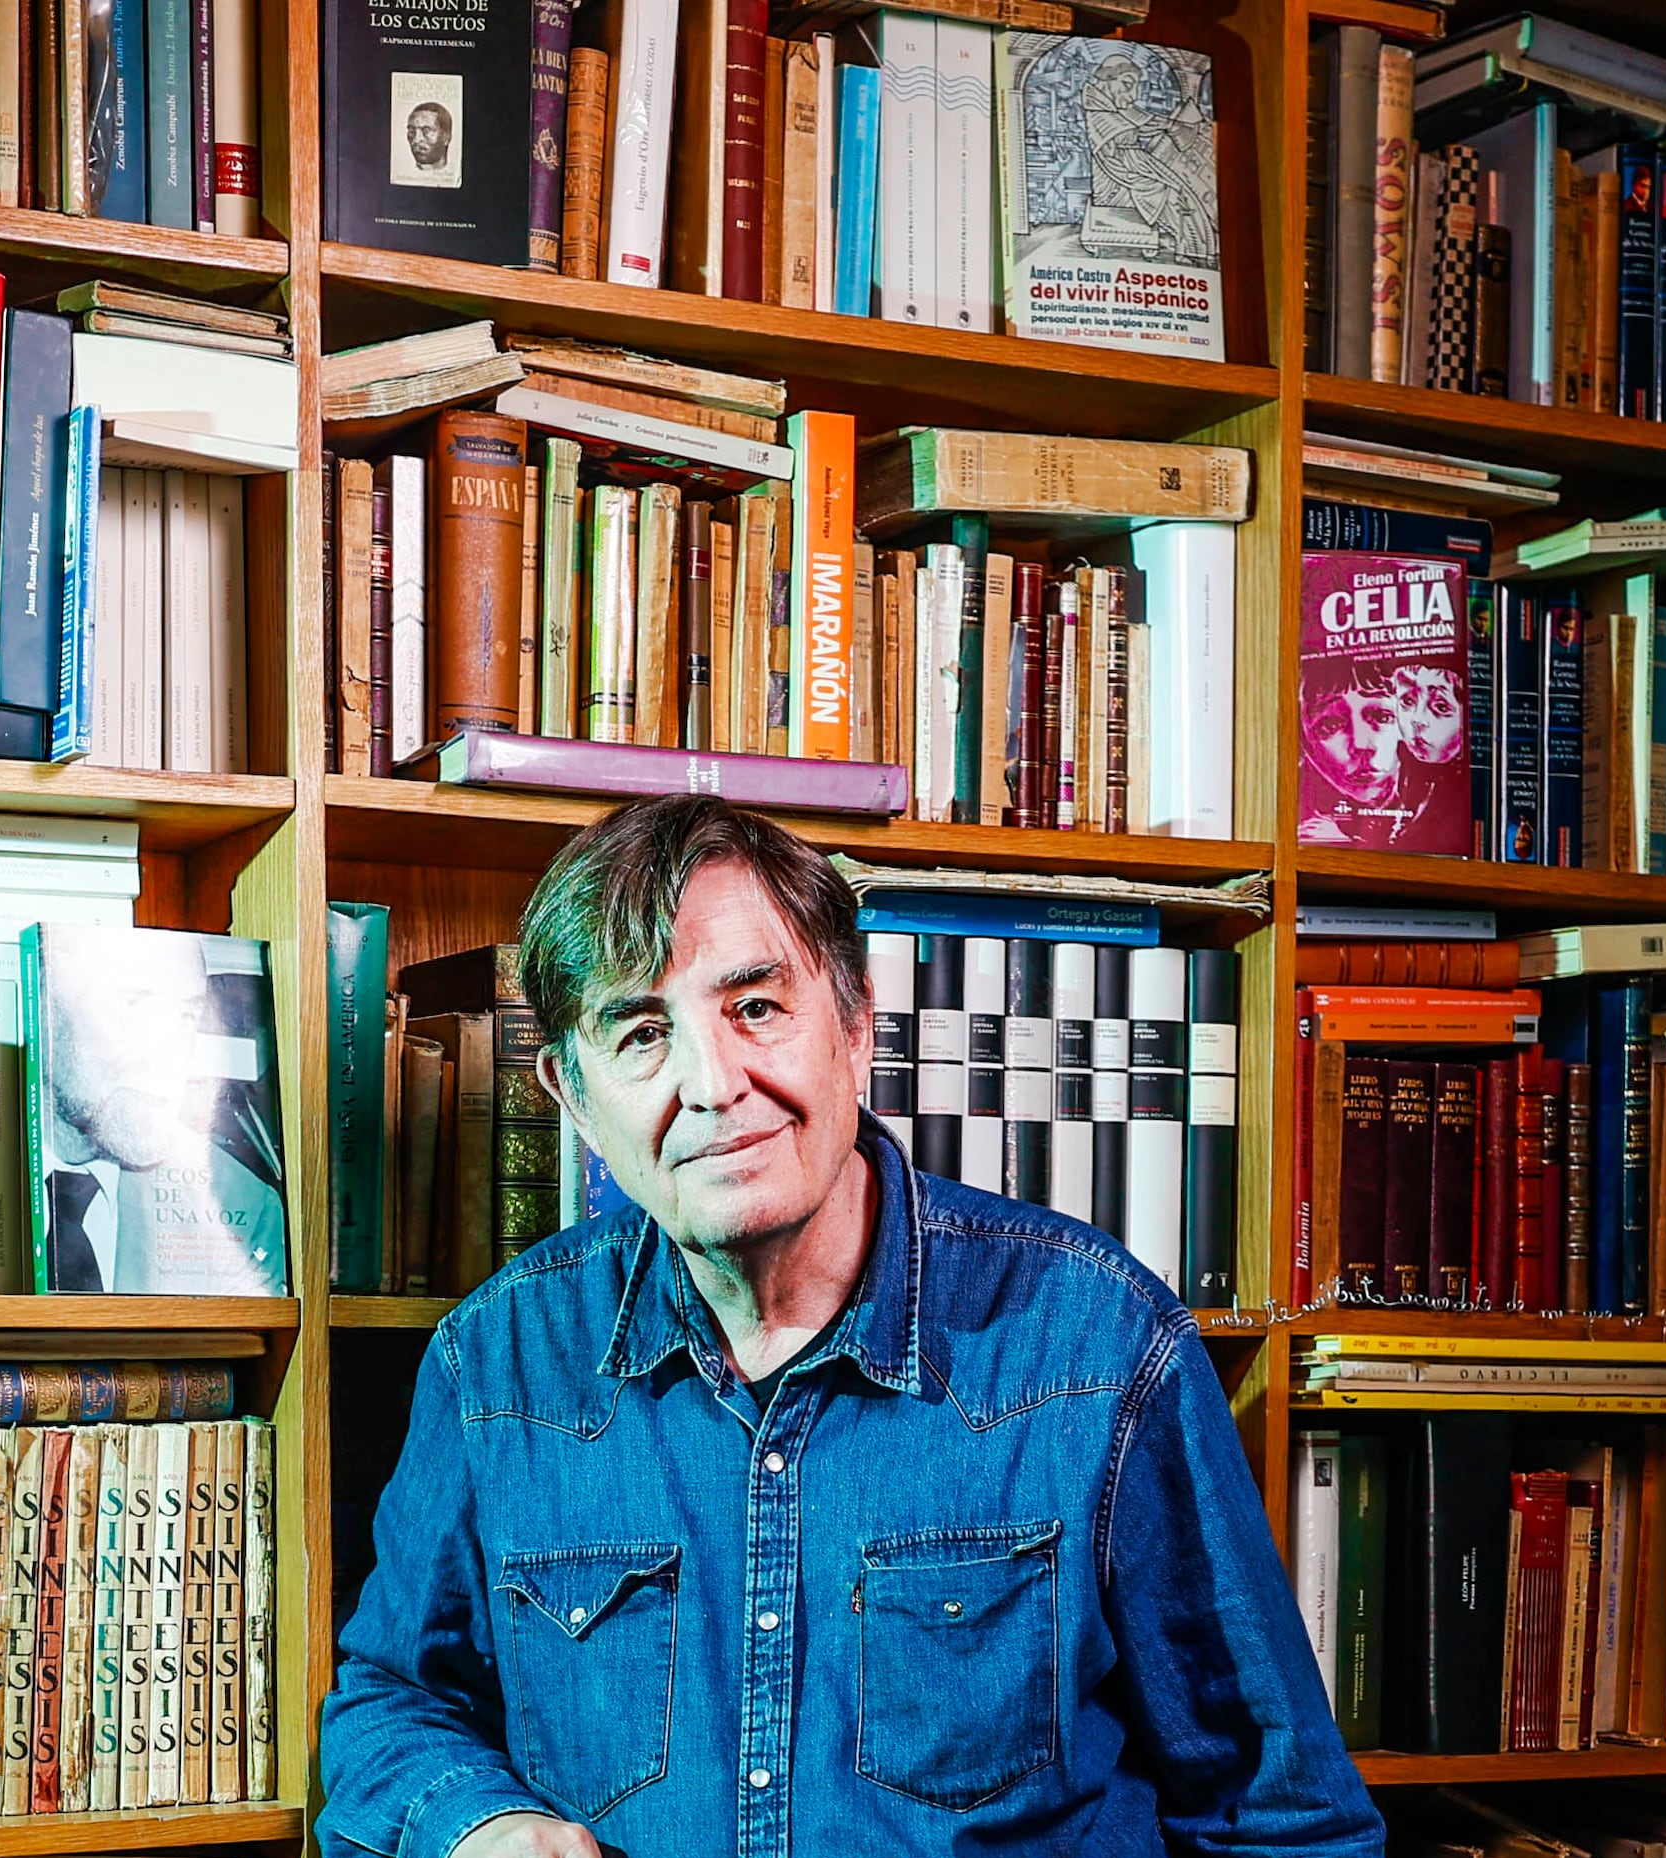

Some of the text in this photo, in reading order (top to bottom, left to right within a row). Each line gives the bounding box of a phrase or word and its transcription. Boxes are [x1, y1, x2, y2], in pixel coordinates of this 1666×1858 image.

[370, 13, 486, 31] LOS CASTÚOS
[166, 94, 179, 144] Camprubí
[200, 60, 211, 144] Correspondencia
[115, 130, 126, 170] Zenobia
[166, 146, 178, 187] Zenobia
[634, 165, 647, 212] Eugenio
[1030, 283, 1209, 311] del vivir hispánico
[1077, 267, 1111, 283] Castro
[1116, 267, 1208, 292] Aspectos
[1031, 314, 1172, 330] personal en los siglos al
[1176, 310, 1210, 323] actitud
[452, 476, 520, 513] ESPAÑA
[25, 511, 40, 553] Jiménez
[24, 554, 38, 591] Ramón
[1353, 567, 1445, 588] Elena Fortún
[24, 593, 37, 617] Juan
[1320, 582, 1454, 633] CELIA
[810, 563, 847, 724] MARAÑÓN
[1326, 633, 1345, 649] EN
[1349, 630, 1366, 646] LA
[1369, 620, 1455, 644] REVOLUCIÓN
[698, 770, 710, 784] el
[709, 761, 721, 793] telón
[1047, 906, 1143, 923] Ortega y Gasset
[1106, 925, 1143, 936] argentino
[338, 973, 355, 1165] ESPAÑA AMÉRICA
[154, 1168, 208, 1184] ECOS
[155, 1187, 182, 1203] DE
[156, 1208, 247, 1226] UNA VOZ
[1296, 1200, 1311, 1270] Bohemia
[1459, 1369, 1569, 1382] EL CIERVO
[1461, 1554, 1470, 1602] LEÓN FELIPE
[5, 1490, 39, 1760] SINTESIS
[36, 1495, 64, 1764] SINTESIS
[95, 1486, 124, 1754] SINTESIS
[124, 1487, 152, 1755] SINTESIS
[153, 1487, 183, 1752] SINTESIS
[185, 1481, 214, 1747] SINTESIS
[216, 1481, 240, 1746] SINTESIS
[1317, 1590, 1326, 1653] Fernando Vela
